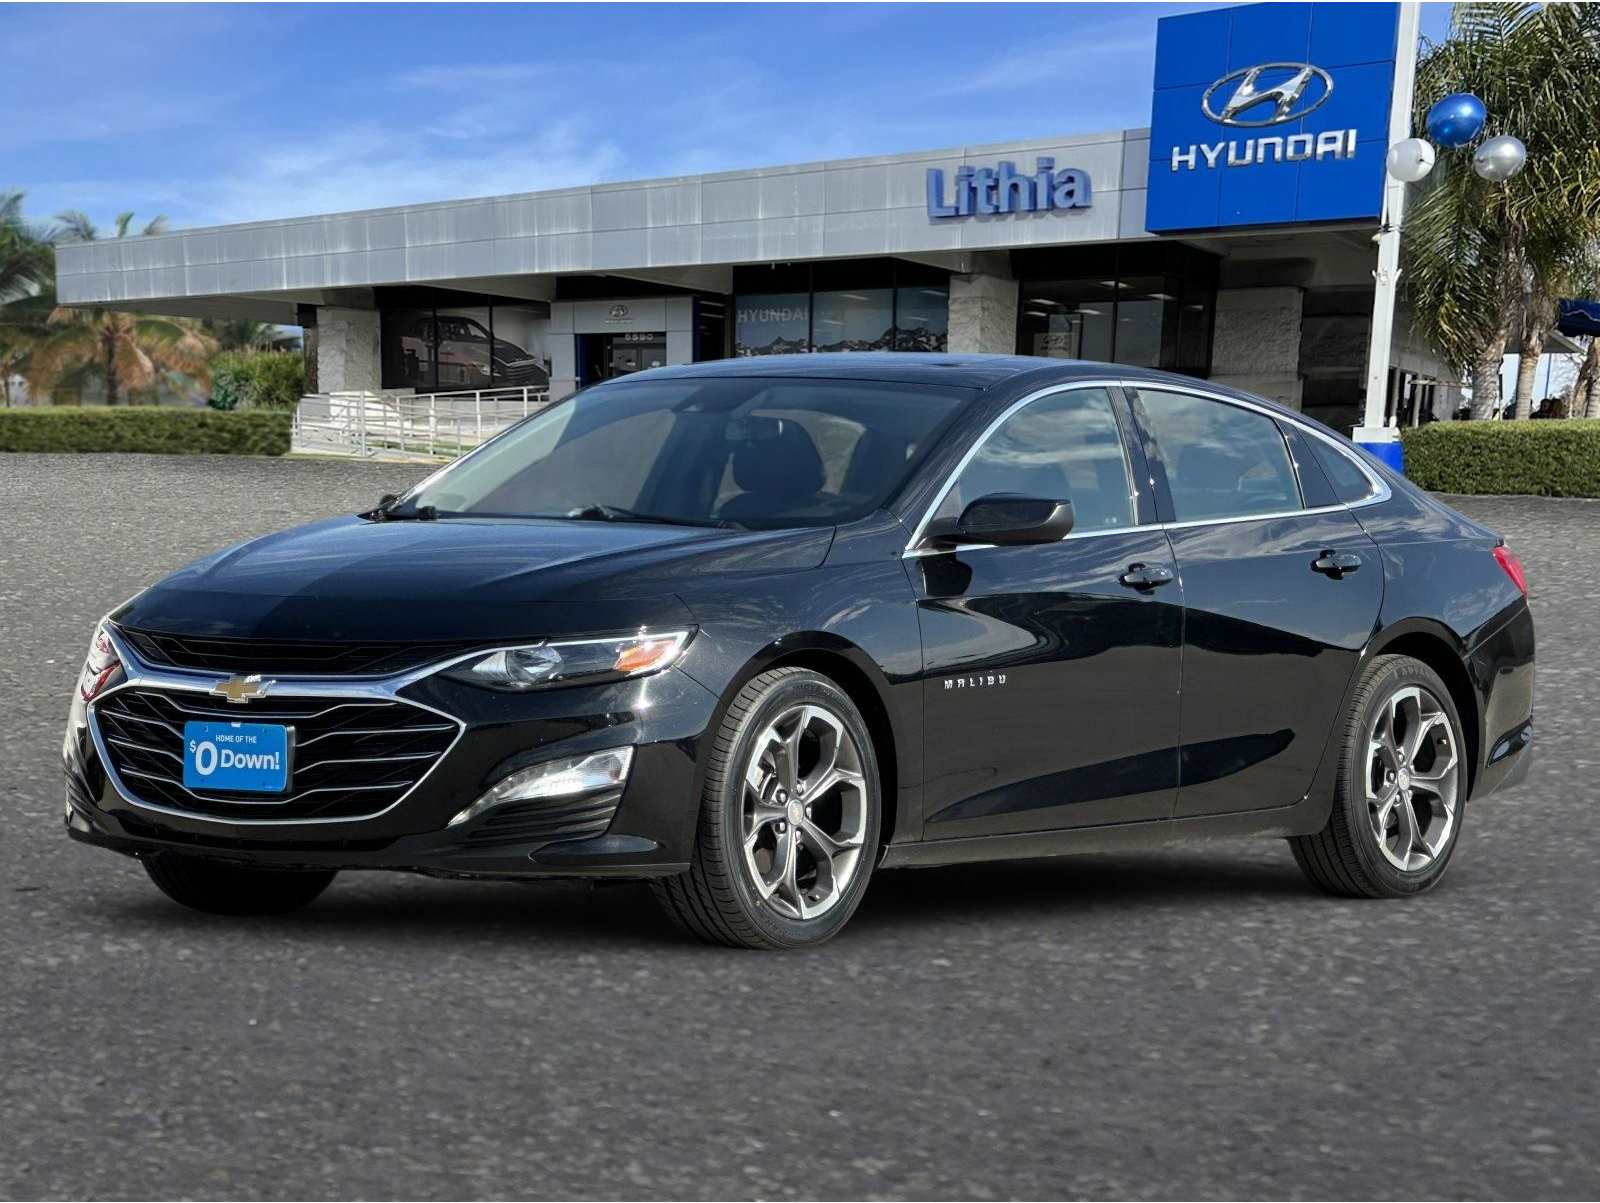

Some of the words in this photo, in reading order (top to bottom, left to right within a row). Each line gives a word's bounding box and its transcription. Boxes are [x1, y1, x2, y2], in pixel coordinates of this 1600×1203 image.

[1171, 128, 1357, 172] HYUNDAI
[926, 157, 1092, 218] Lithia
[737, 308, 809, 323] HYUNDAI
[944, 674, 1007, 690] MALIBU
[215, 734, 234, 743] HOME
[235, 735, 245, 743] OF
[245, 735, 257, 744] THE
[220, 749, 280, 770] Down!
